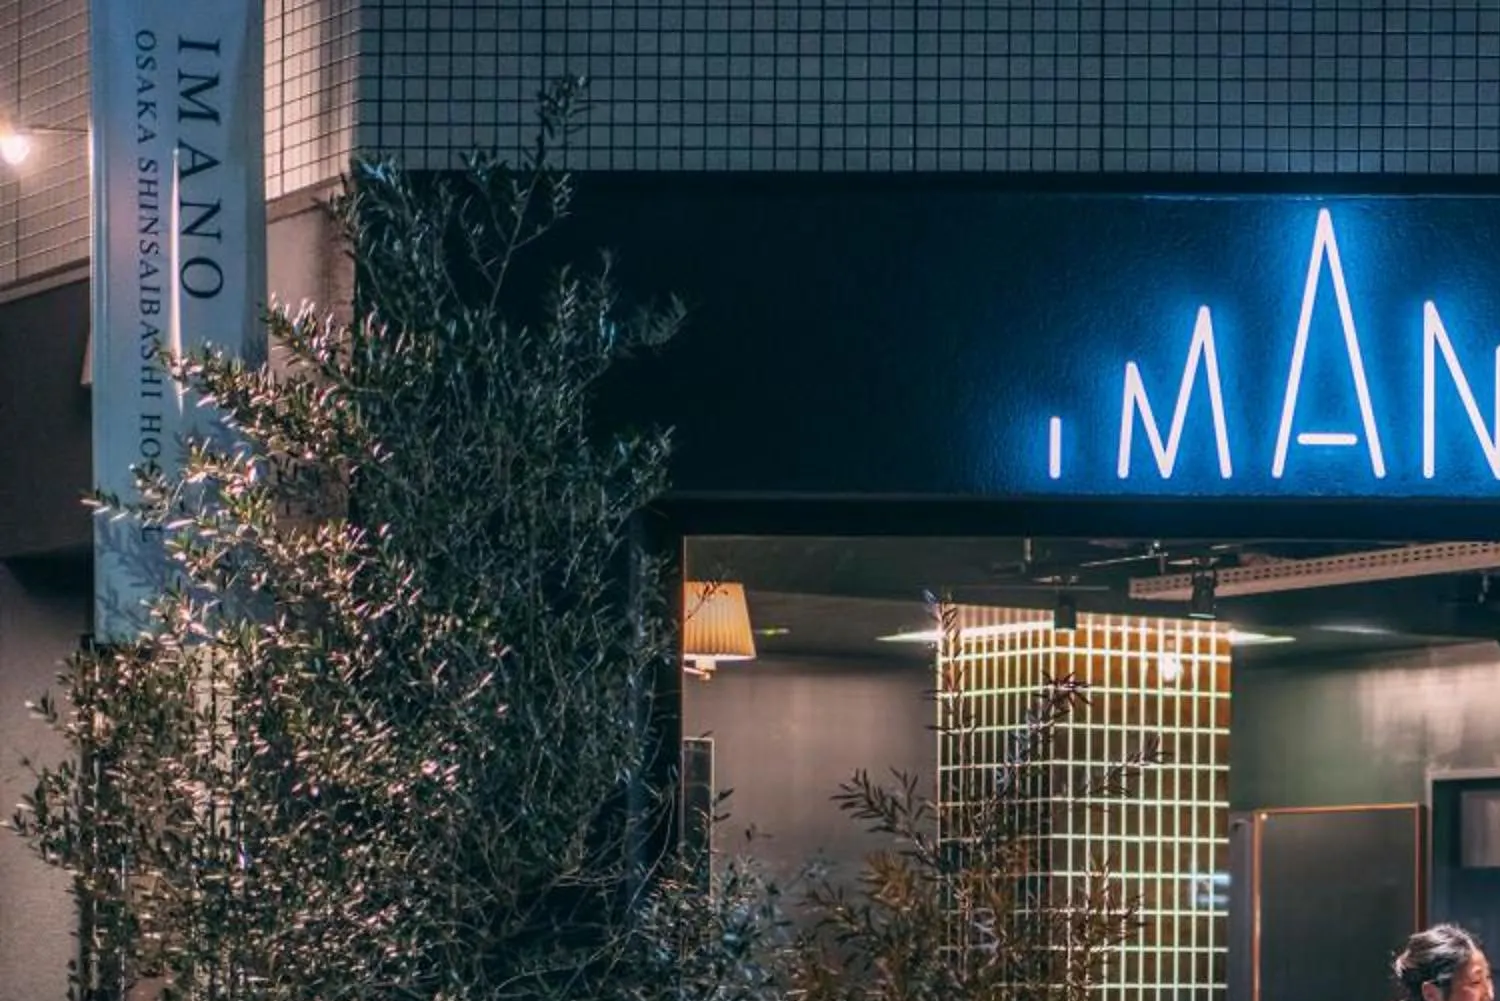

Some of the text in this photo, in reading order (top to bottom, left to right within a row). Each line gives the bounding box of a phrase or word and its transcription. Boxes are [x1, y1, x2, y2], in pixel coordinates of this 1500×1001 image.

[135, 30, 163, 543] OSAKA SHINSAIBASHI HOL
[177, 34, 224, 300] IMANO
